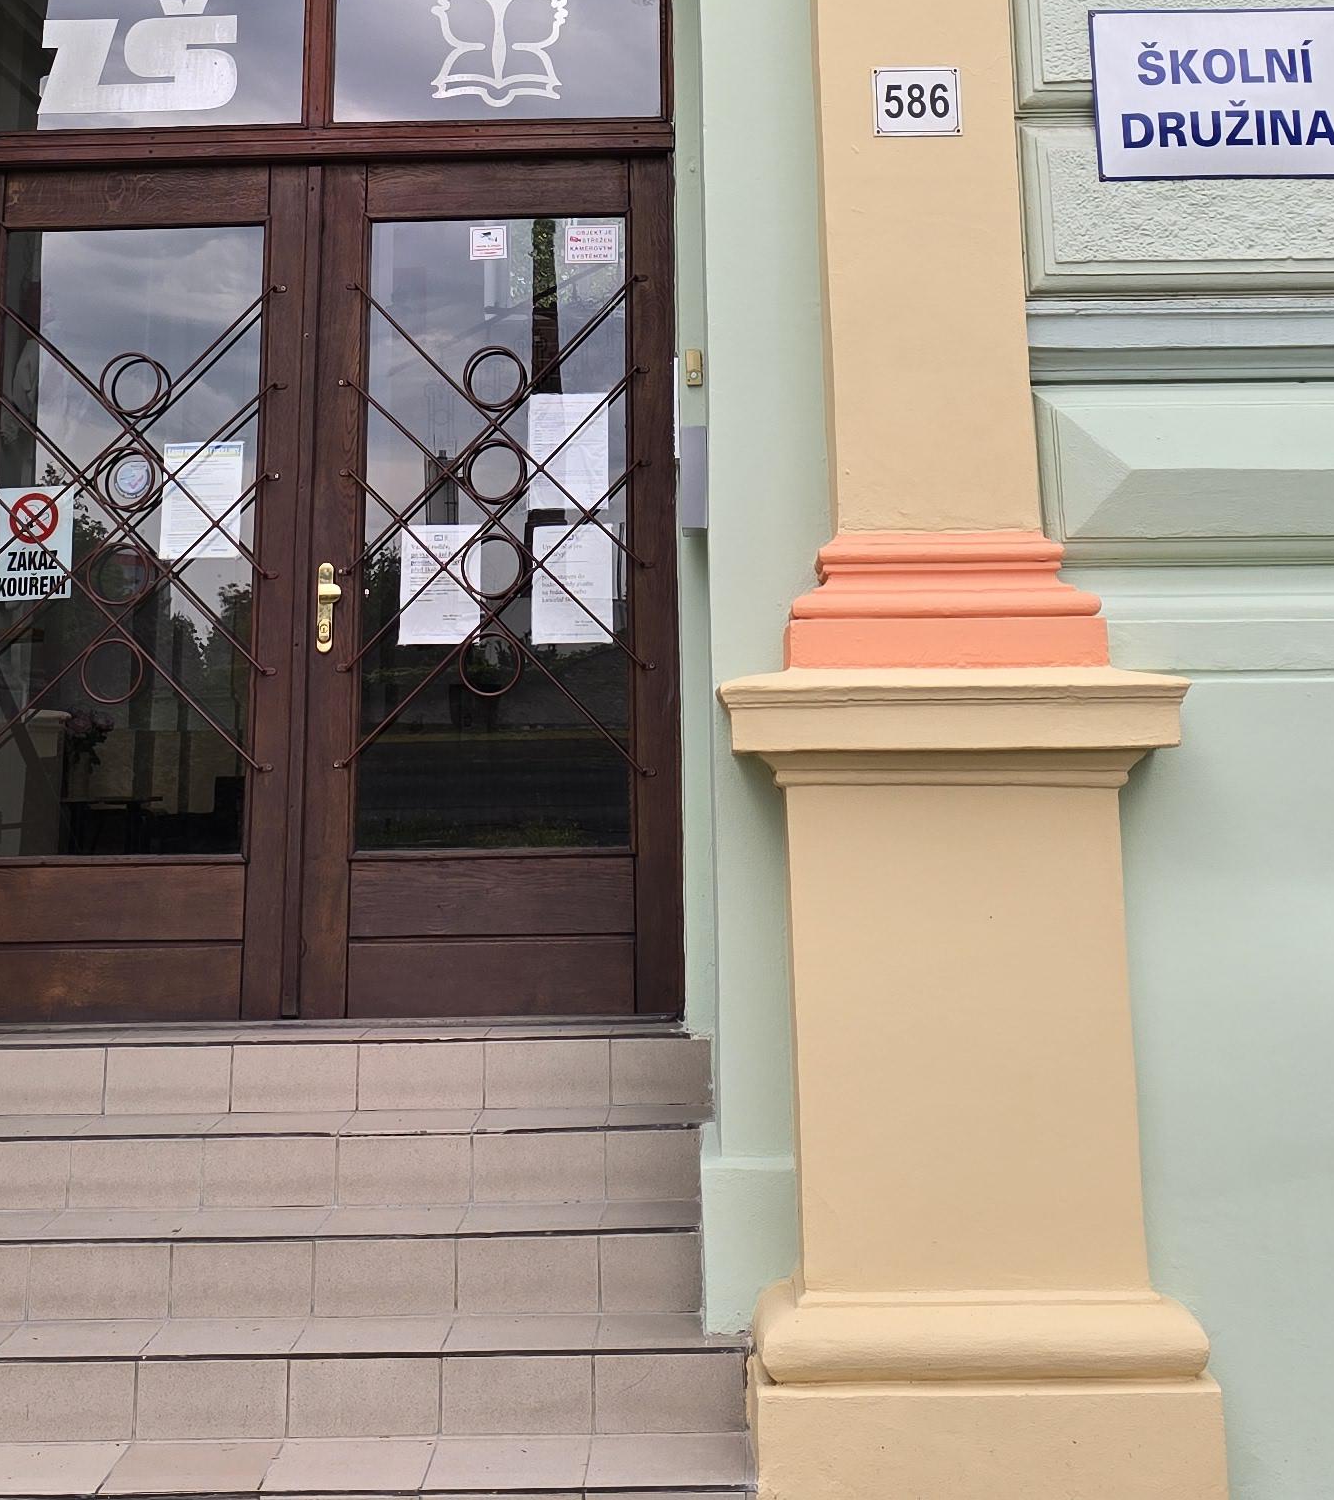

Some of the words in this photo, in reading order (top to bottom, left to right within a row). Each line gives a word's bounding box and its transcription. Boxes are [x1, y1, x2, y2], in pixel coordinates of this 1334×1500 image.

[1136, 39, 1314, 87] ŠKOLNÍ
[883, 83, 951, 120] 586
[7, 547, 58, 572] ZÁKAZ
